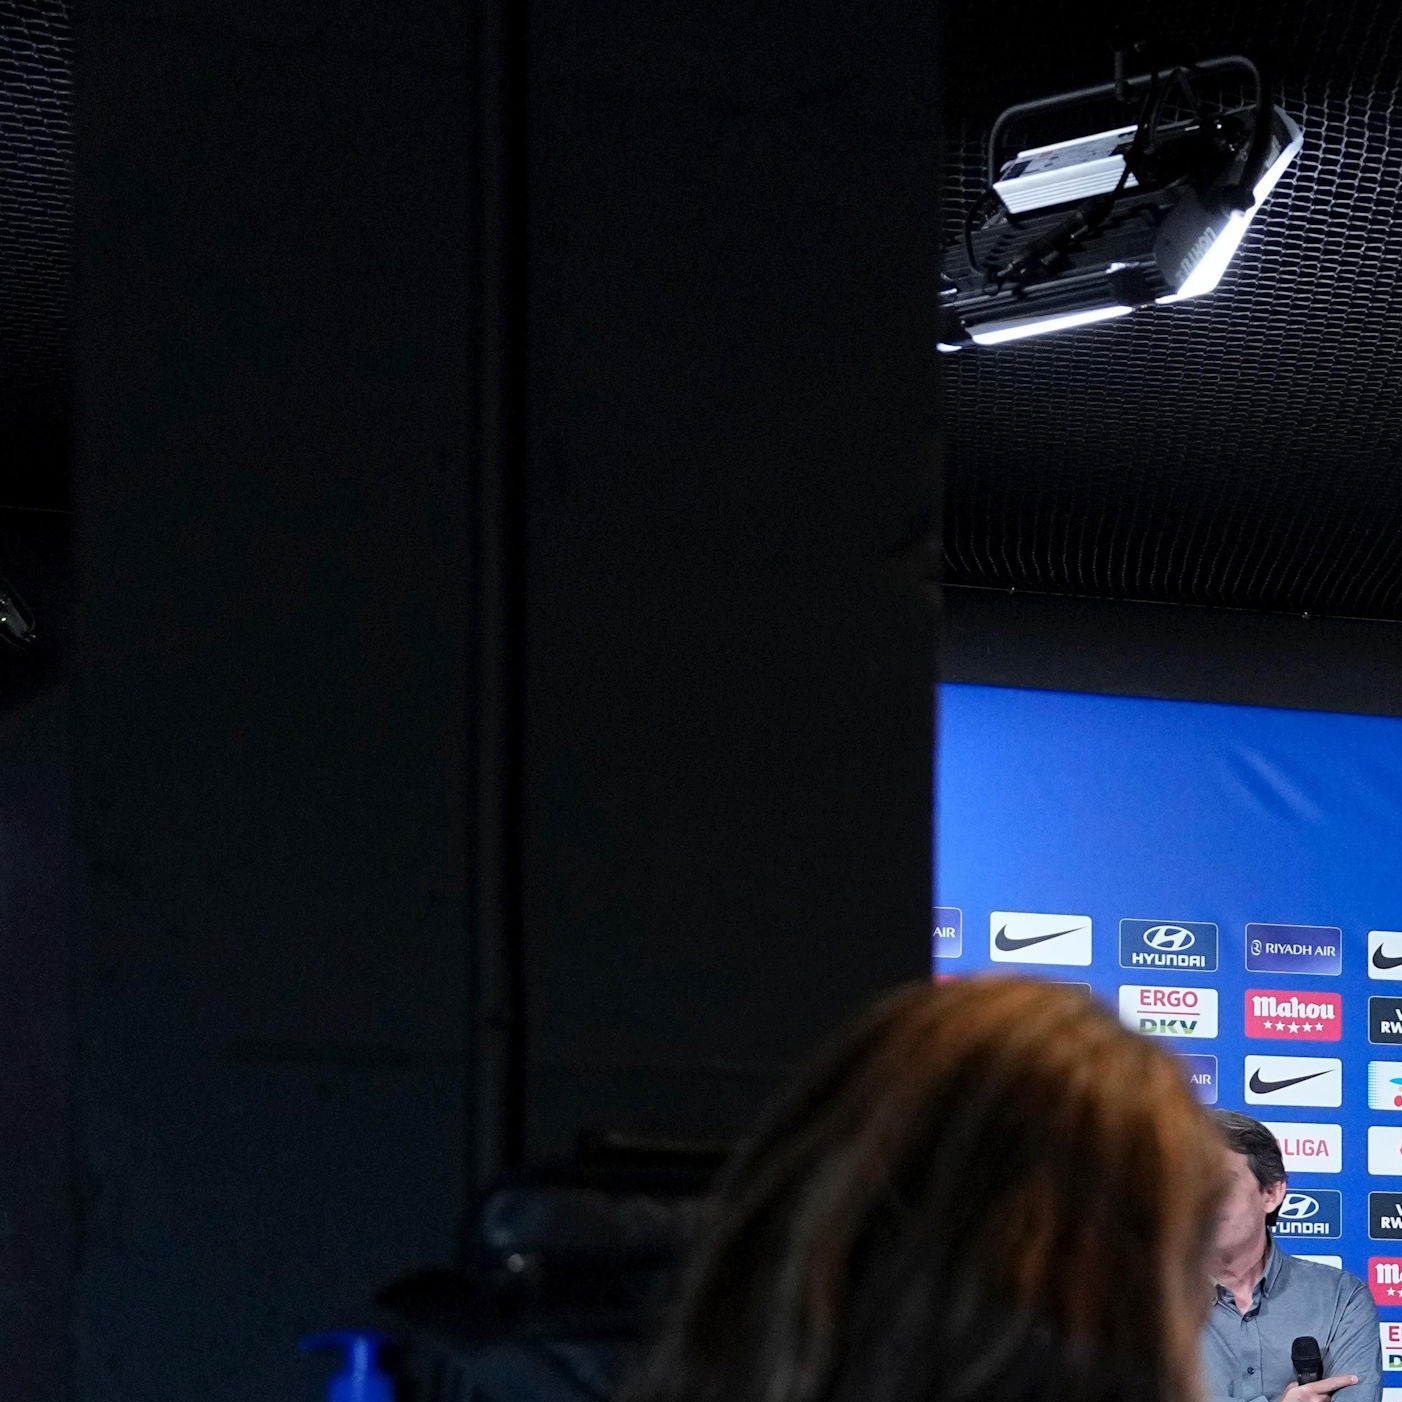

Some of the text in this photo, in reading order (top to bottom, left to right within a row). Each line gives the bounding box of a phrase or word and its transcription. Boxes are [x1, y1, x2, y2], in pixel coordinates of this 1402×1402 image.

[932, 926, 956, 938] AIR
[1265, 942, 1336, 957] RIYADH AIR
[1132, 952, 1205, 967] HYUNDAI
[1140, 989, 1199, 1008] ERGO
[1251, 995, 1335, 1020] Mahou
[1190, 1073, 1212, 1085] AIR
